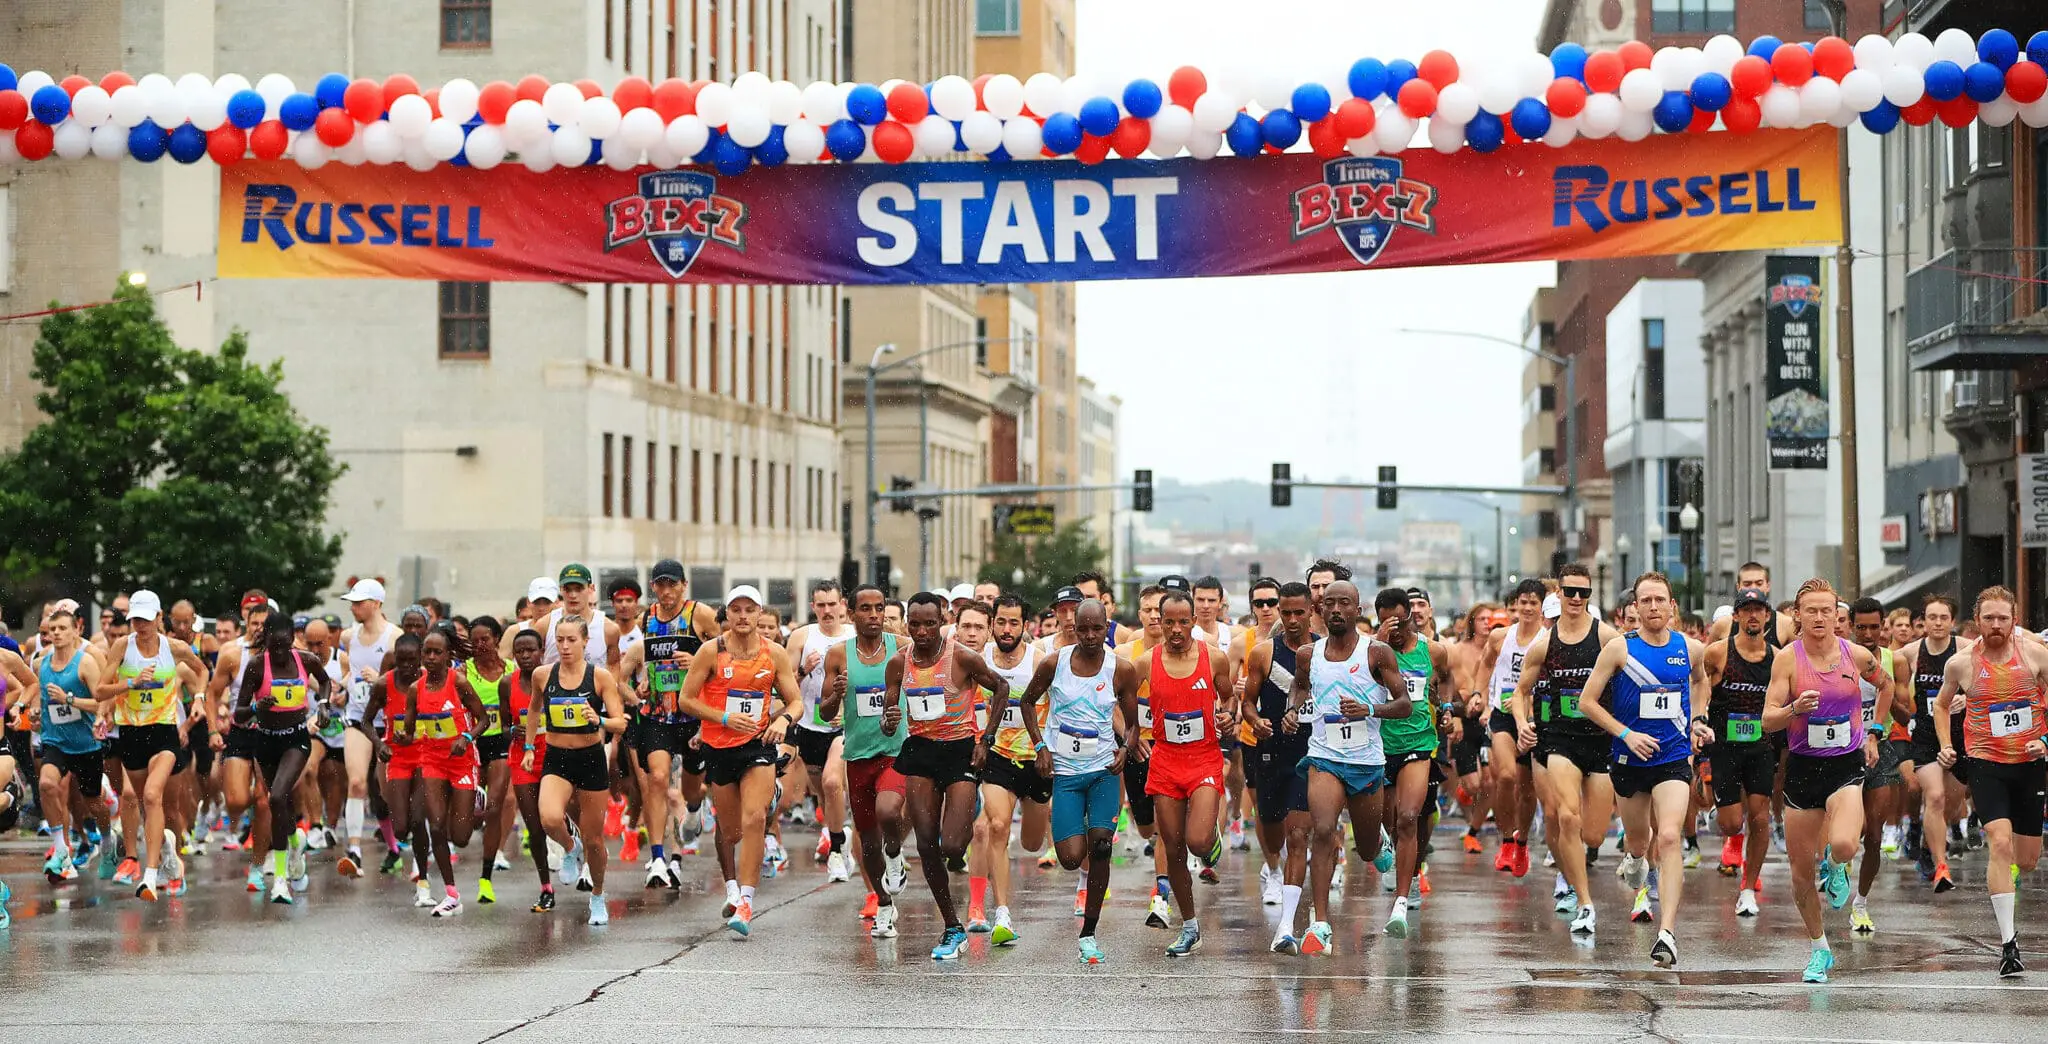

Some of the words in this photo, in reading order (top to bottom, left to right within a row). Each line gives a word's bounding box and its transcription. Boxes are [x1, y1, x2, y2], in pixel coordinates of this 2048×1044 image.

[1335, 162, 1391, 182] Times
[1552, 164, 1816, 233] RUSSELL
[241, 184, 495, 251] RUSSELL
[856, 177, 1179, 267] START
[1358, 235, 1376, 249] 1975
[1784, 322, 1808, 336] RUN
[1782, 337, 1812, 350] WITH
[1785, 351, 1807, 365] THE
[1780, 365, 1813, 379] BEST!
[1771, 446, 1810, 458] Walmart
[650, 642, 672, 652] FLEET
[1666, 657, 1687, 666] GRC
[140, 692, 153, 703] 24
[285, 689, 292, 701] 6
[868, 695, 884, 708] 49
[740, 701, 752, 713] 15
[922, 699, 929, 712] 1
[1655, 696, 1668, 710] 41
[56, 705, 72, 717] 154
[562, 707, 575, 720] 16
[1145, 709, 1152, 721] 4
[2004, 713, 2020, 728] 29
[1176, 722, 1191, 737] 25
[1340, 726, 1352, 740] 17
[1736, 723, 1755, 735] 509
[1826, 728, 1835, 741] 9
[1072, 740, 1081, 753] 3
